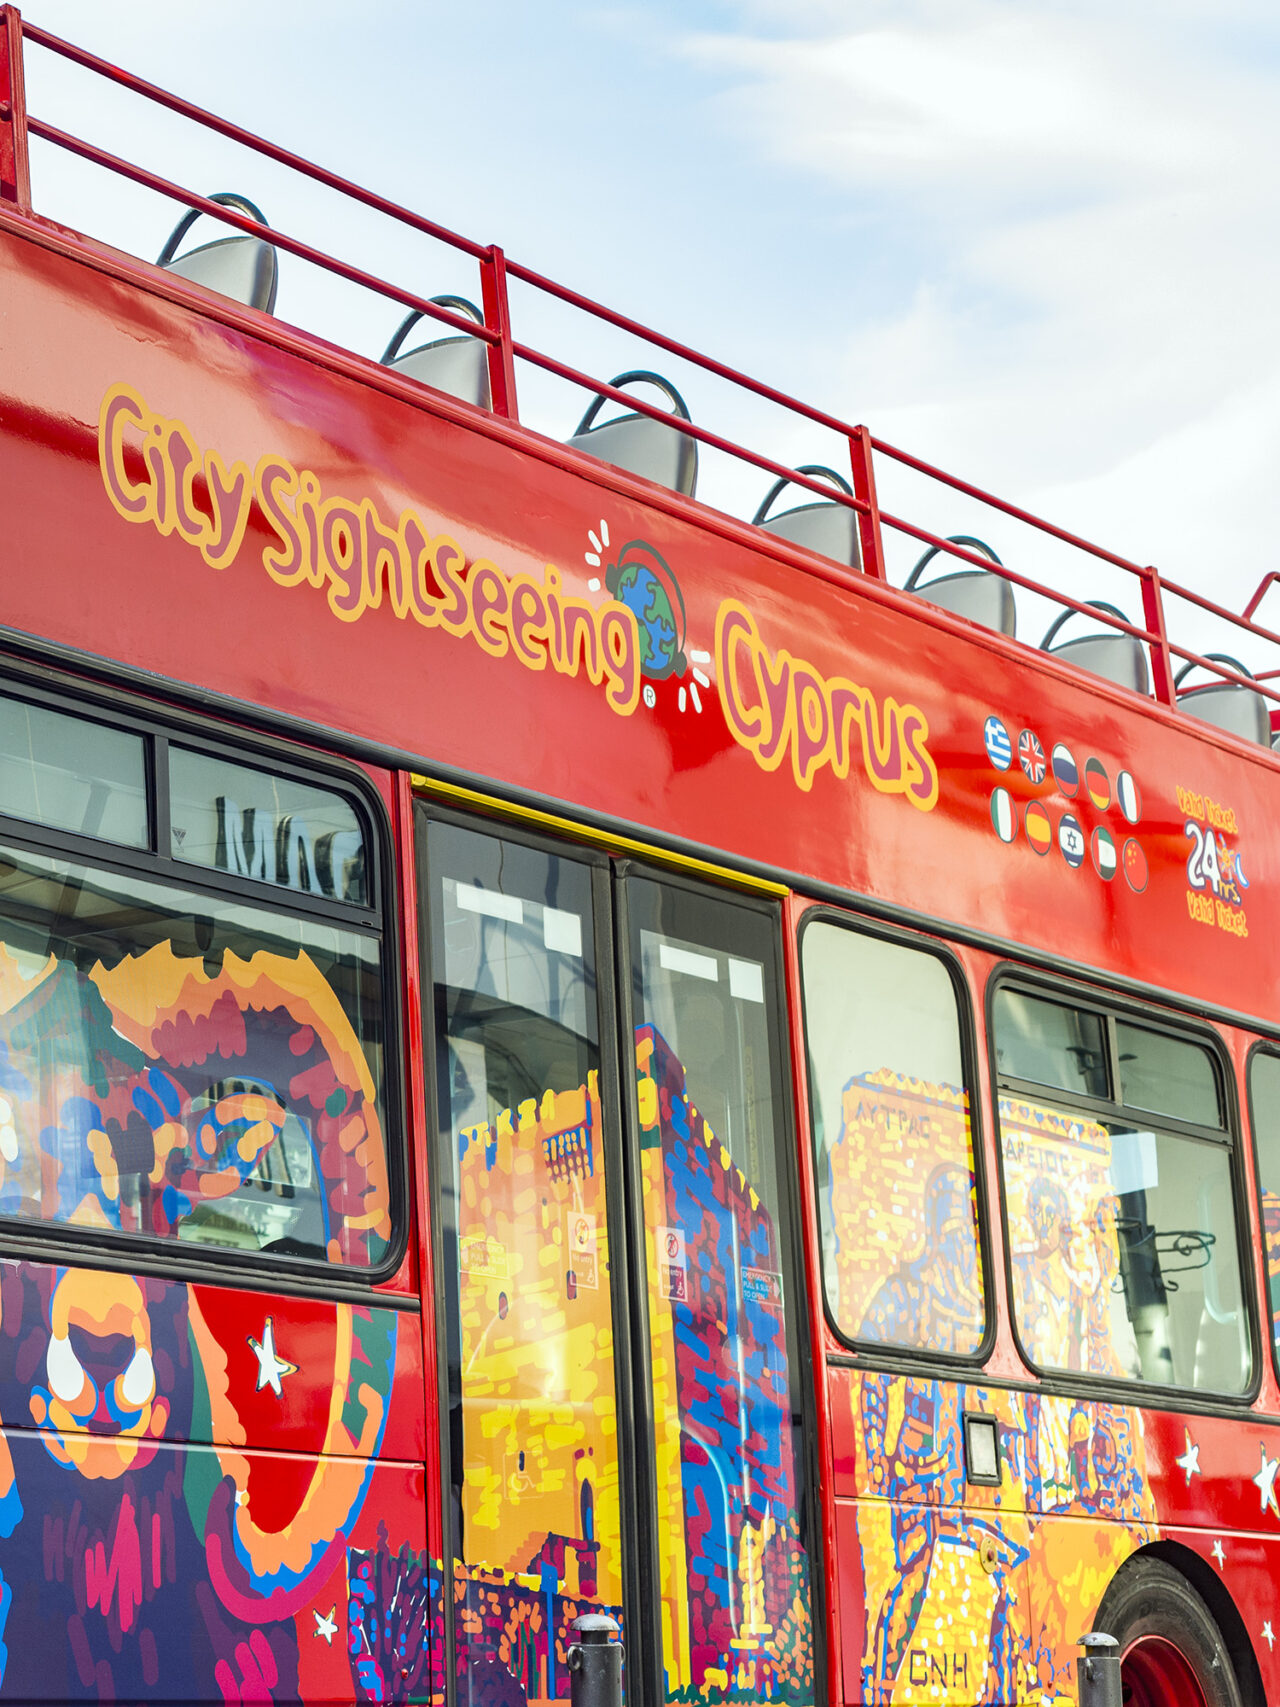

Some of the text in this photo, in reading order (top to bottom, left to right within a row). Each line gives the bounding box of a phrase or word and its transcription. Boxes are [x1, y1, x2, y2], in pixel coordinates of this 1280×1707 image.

[99, 382, 938, 811] City Sightseeing Cyprus
[1185, 819, 1221, 895] 24
